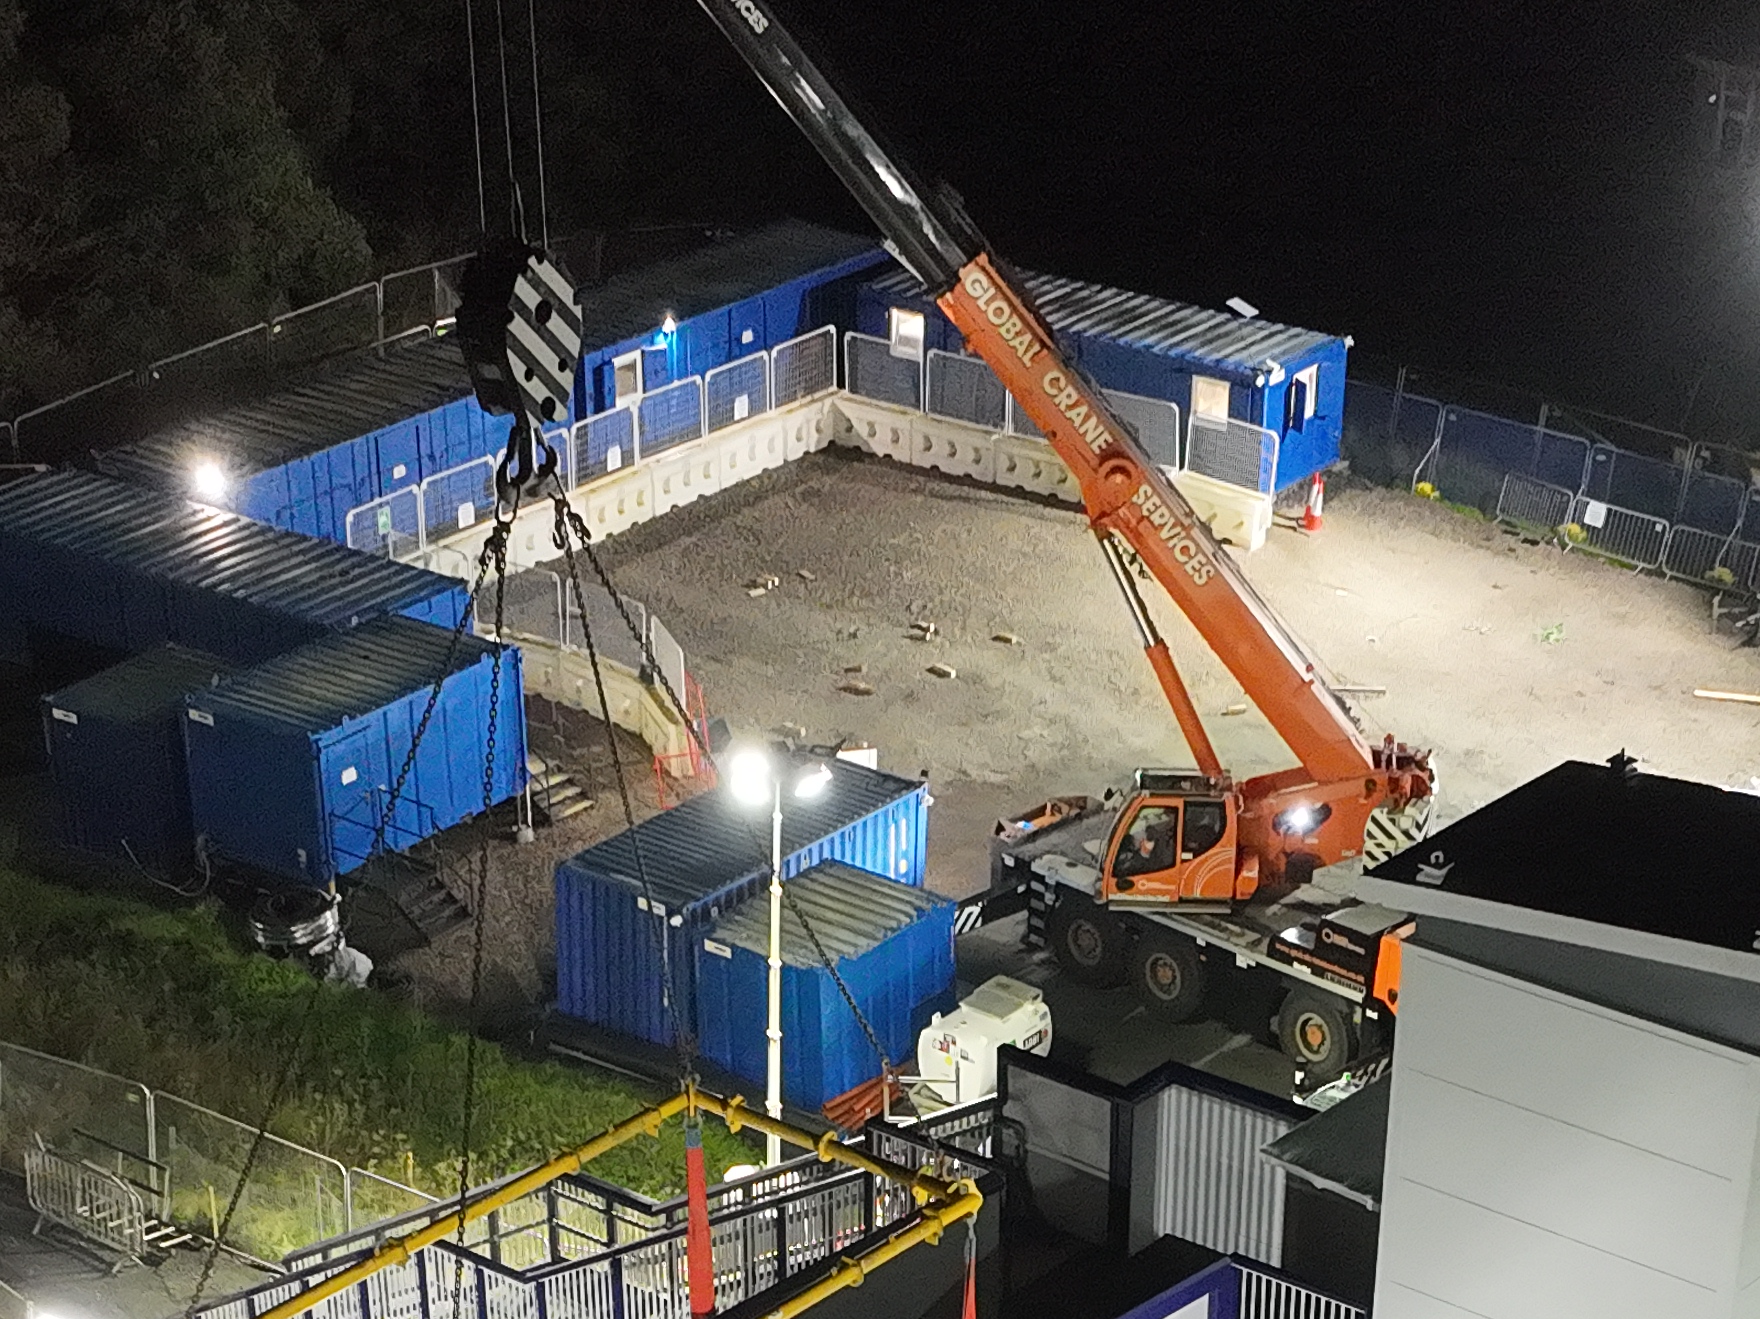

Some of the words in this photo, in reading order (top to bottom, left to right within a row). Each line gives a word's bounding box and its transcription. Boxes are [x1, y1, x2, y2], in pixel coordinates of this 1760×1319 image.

[965, 271, 1043, 369] GLOBAL
[1042, 370, 1113, 454] CRANE
[1132, 484, 1215, 586] SERVICES
